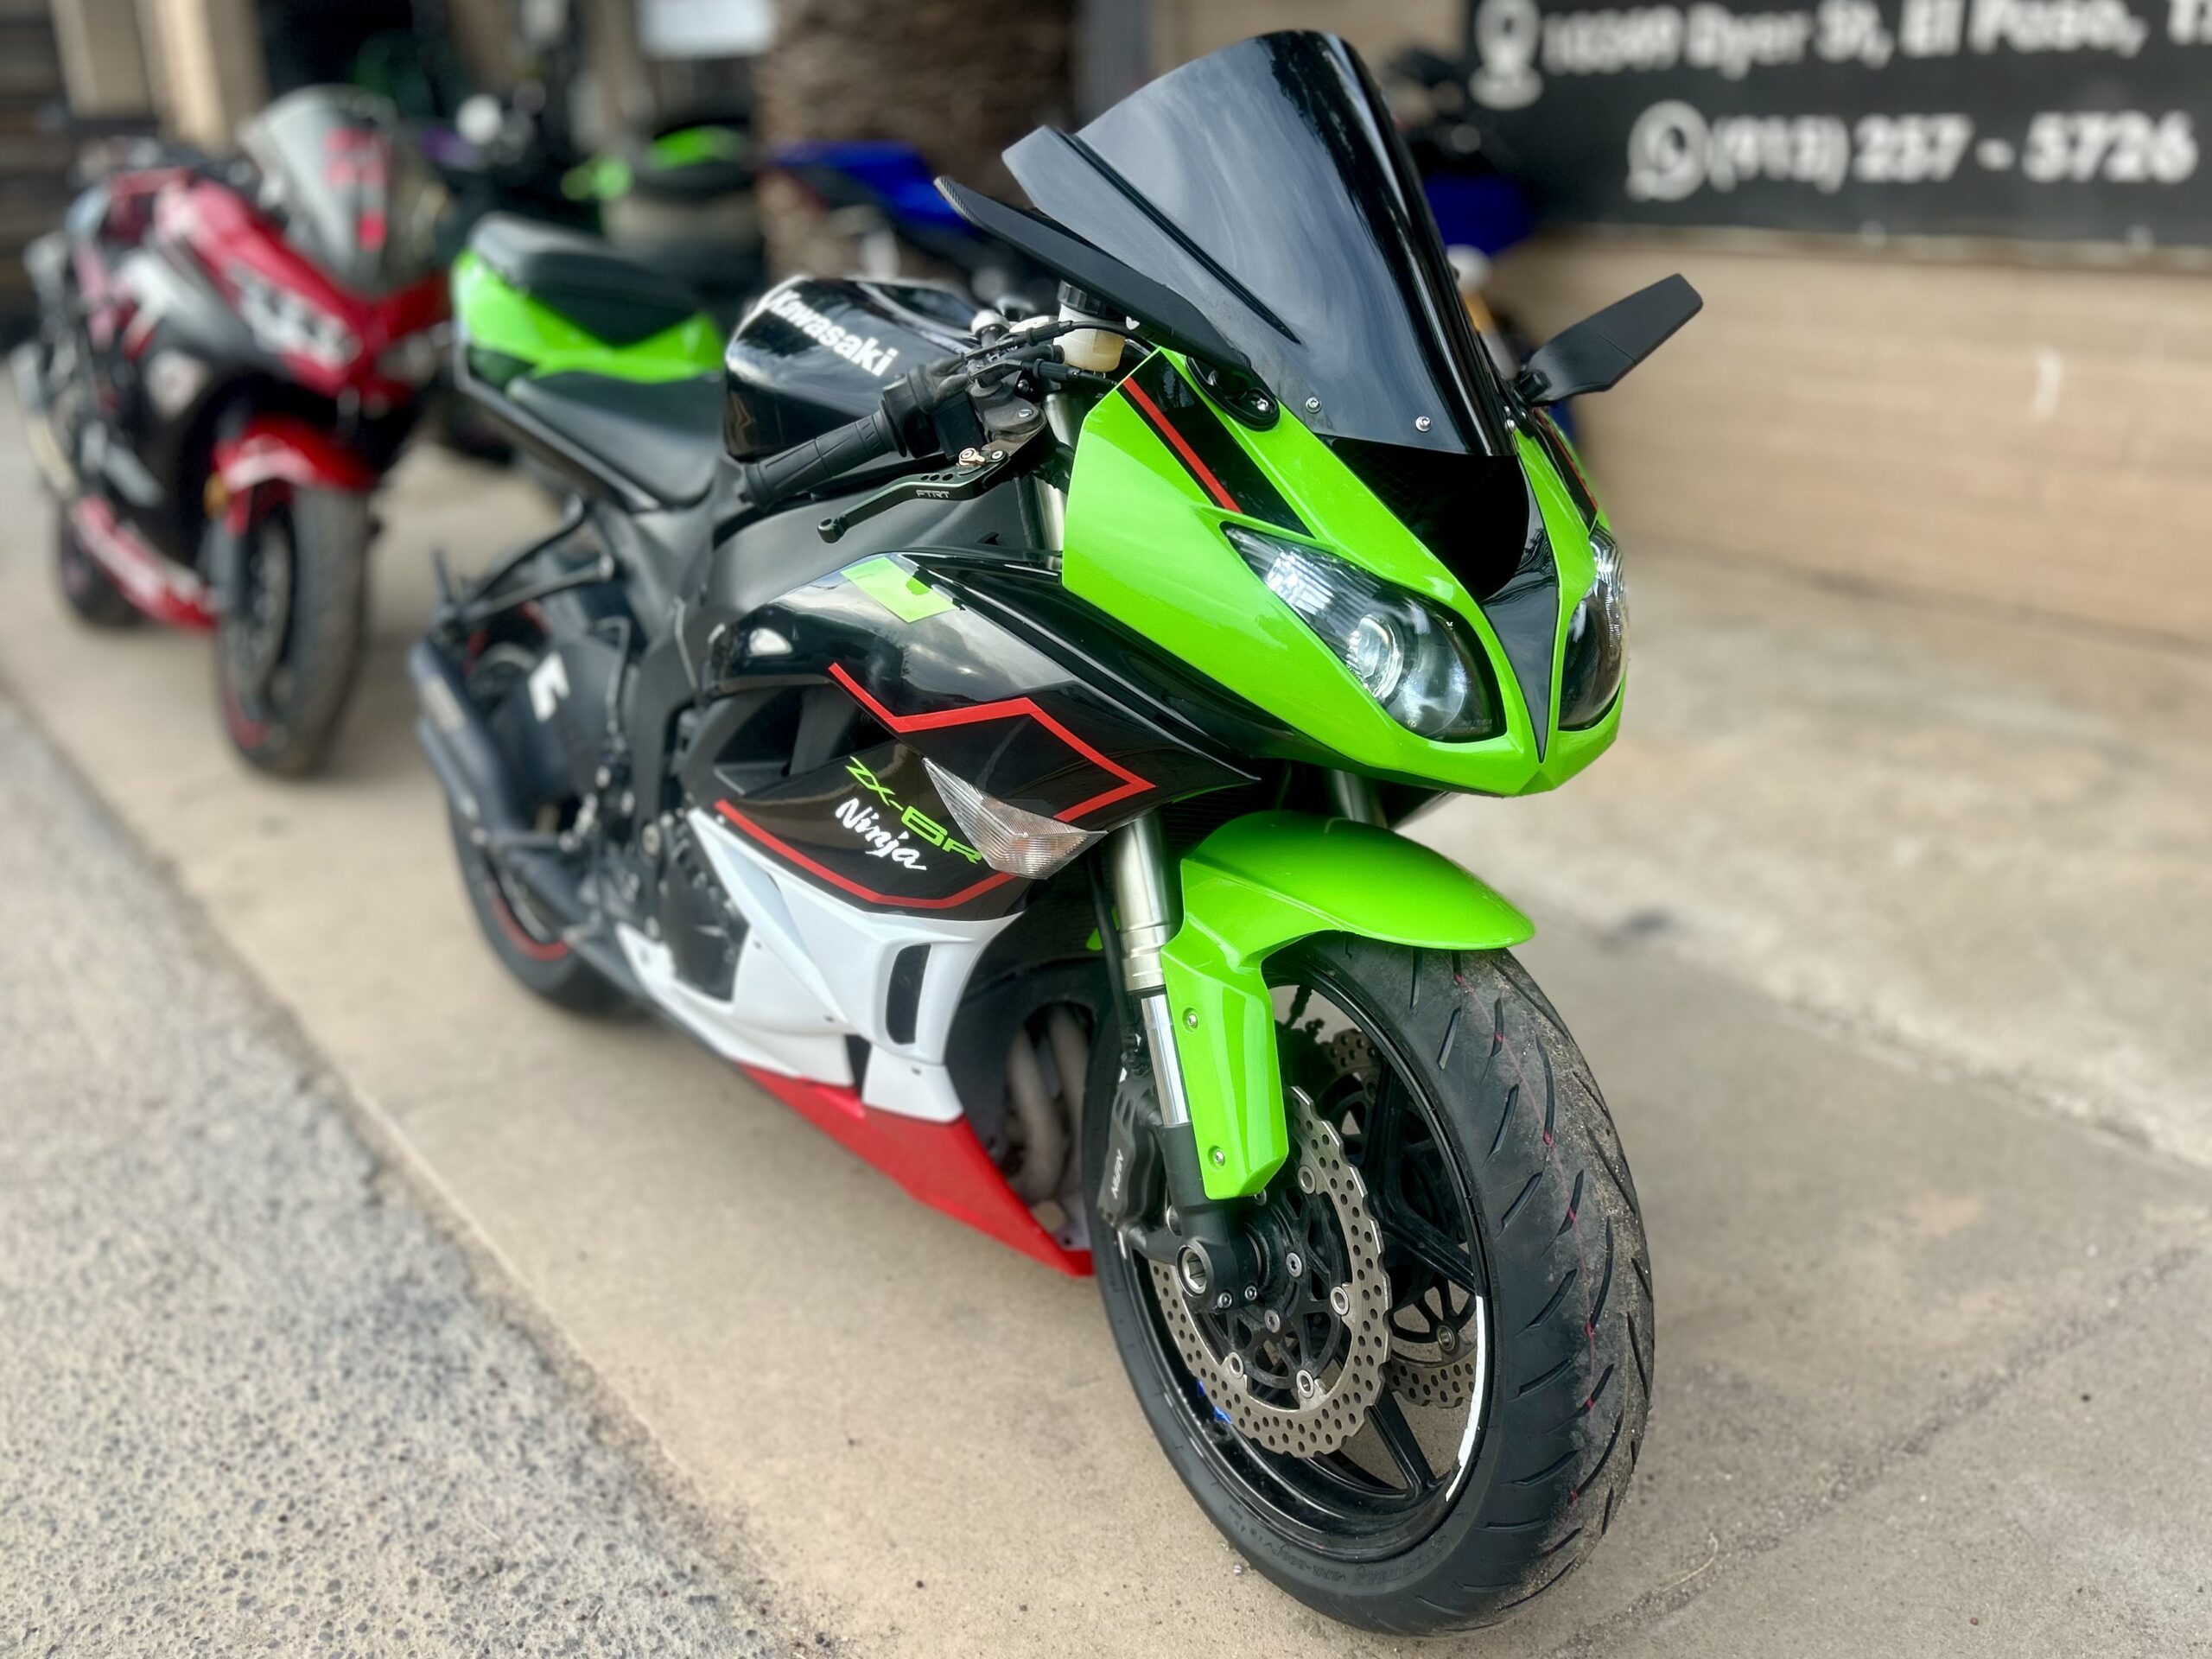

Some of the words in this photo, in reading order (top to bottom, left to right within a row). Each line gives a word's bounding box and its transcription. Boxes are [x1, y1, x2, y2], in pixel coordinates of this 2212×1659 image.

[770, 289, 899, 377] Kawasaki
[835, 798, 927, 870] Ninja
[845, 756, 982, 864] ZX-6R
